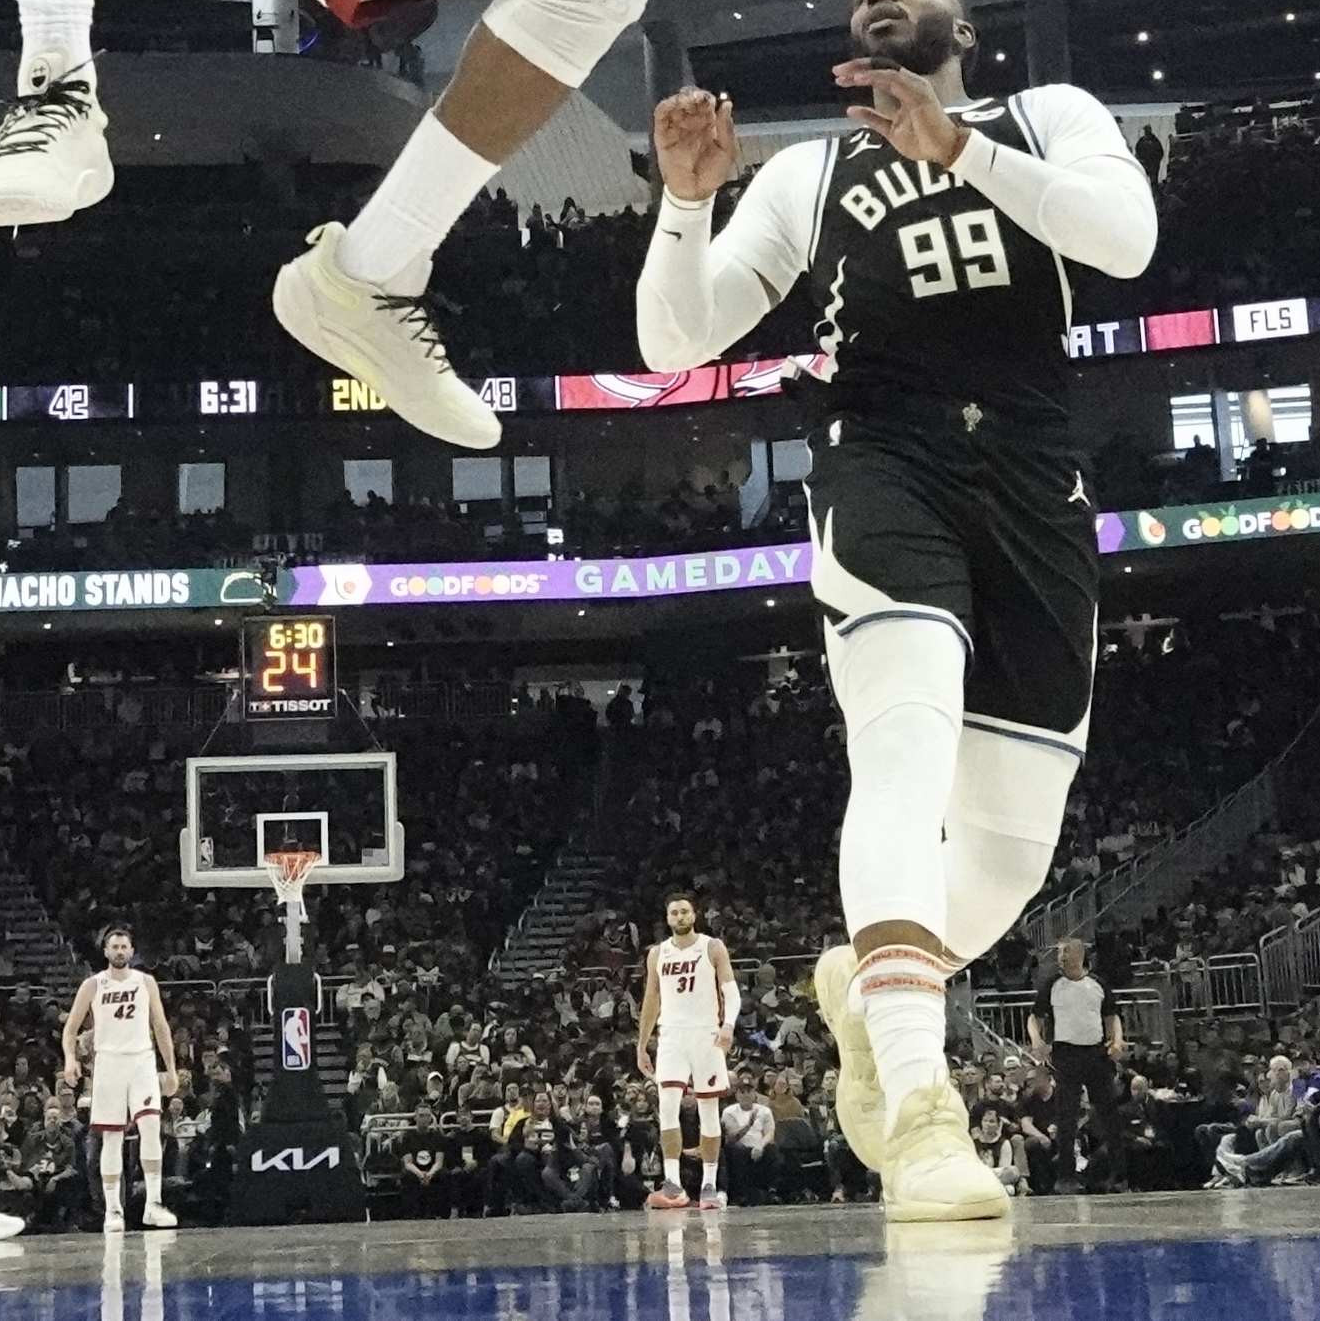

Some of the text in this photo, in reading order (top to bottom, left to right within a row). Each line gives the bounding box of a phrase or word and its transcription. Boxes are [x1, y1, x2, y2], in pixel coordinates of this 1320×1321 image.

[840, 160, 965, 231] BUC
[898, 208, 1011, 298] 99
[1070, 322, 1120, 359] AT
[1250, 307, 1292, 333] FLS
[49, 384, 89, 420] 42
[200, 381, 256, 414] 6:31
[479, 377, 516, 412] 48
[84, 572, 190, 606] STANDS
[575, 548, 801, 595] GAMEDAY
[270, 623, 324, 649] 6:30
[263, 651, 317, 692] 24
[661, 954, 702, 976] HEAT
[101, 986, 139, 1005] HEAT
[676, 976, 695, 993] 31
[114, 1004, 135, 1020] 42
